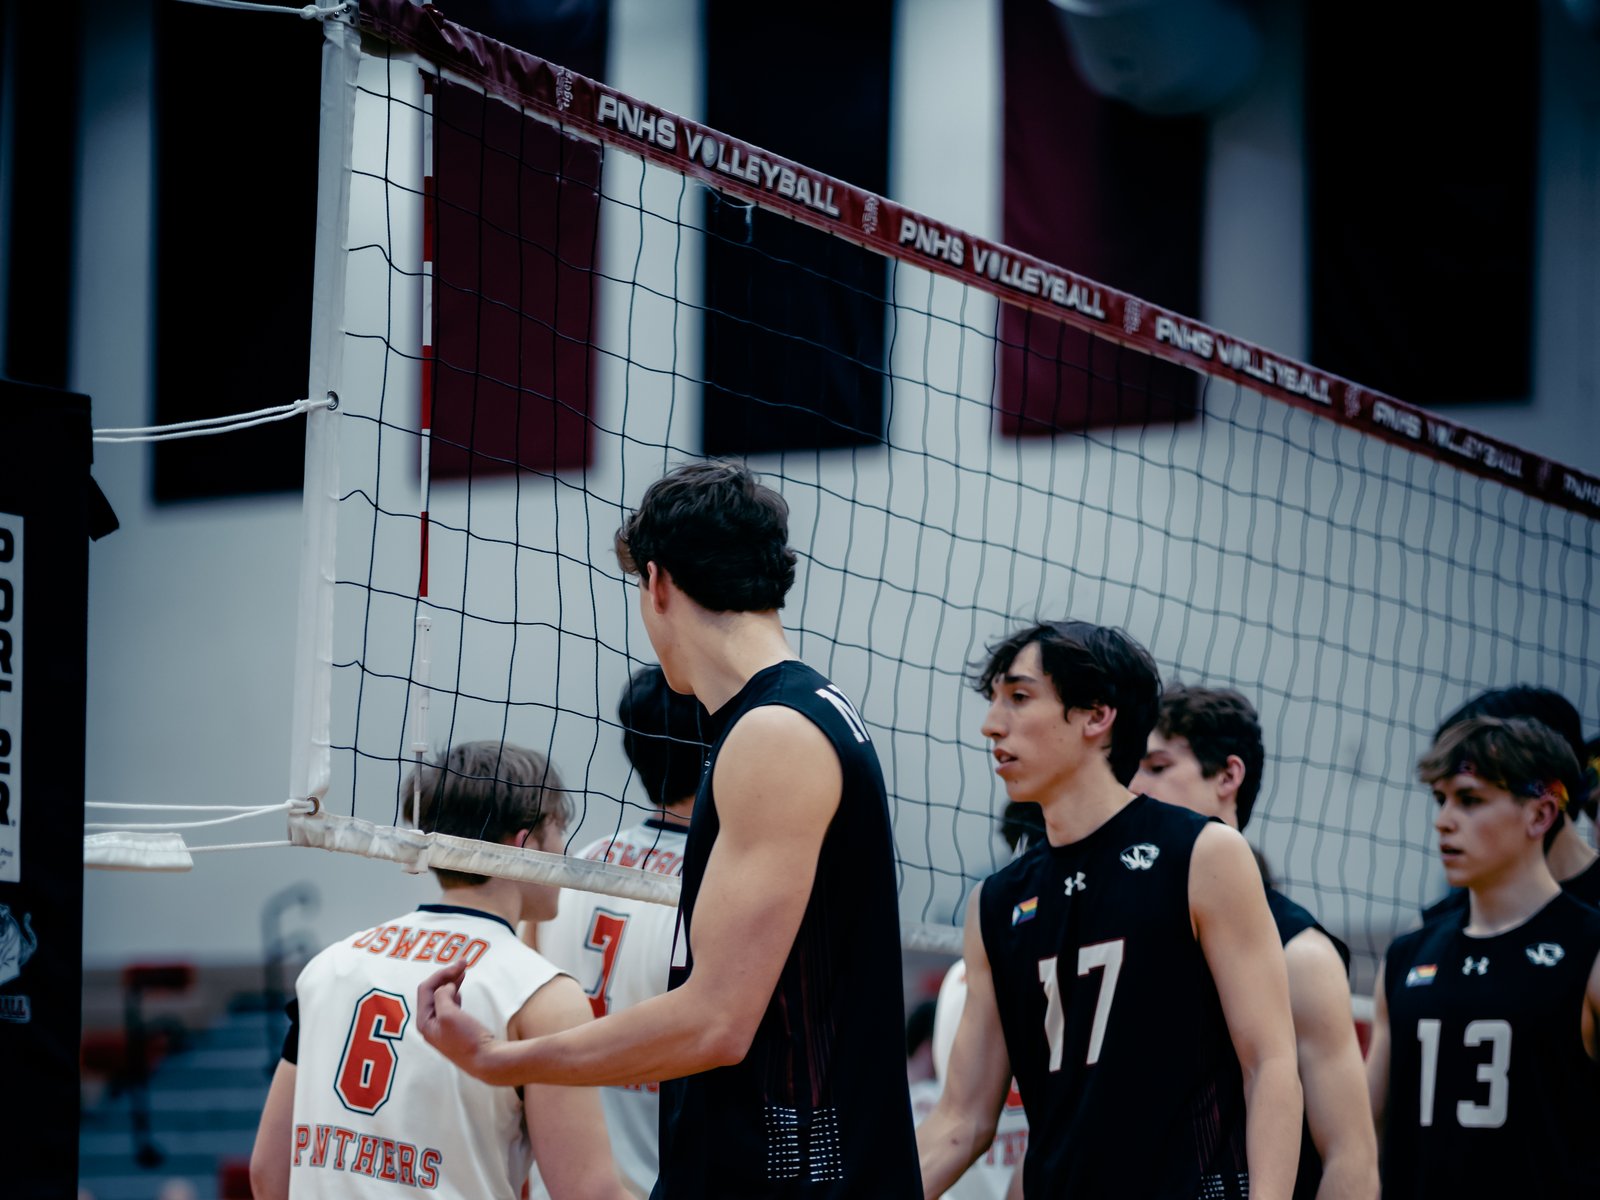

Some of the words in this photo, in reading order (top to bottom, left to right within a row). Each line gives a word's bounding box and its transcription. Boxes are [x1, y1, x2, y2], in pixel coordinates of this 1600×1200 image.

[598, 94, 677, 150] PNHS
[685, 127, 839, 217] VOLLEYBALL
[899, 218, 965, 267] PNHS
[971, 245, 1105, 320] VOLLEYBALL
[1154, 314, 1214, 359] PNHS
[1215, 335, 1333, 405] VOLLEYBALL
[352, 925, 490, 969] OSWEGO
[333, 987, 411, 1117] 6
[1038, 937, 1125, 1074] 17
[1416, 1018, 1512, 1128] 13
